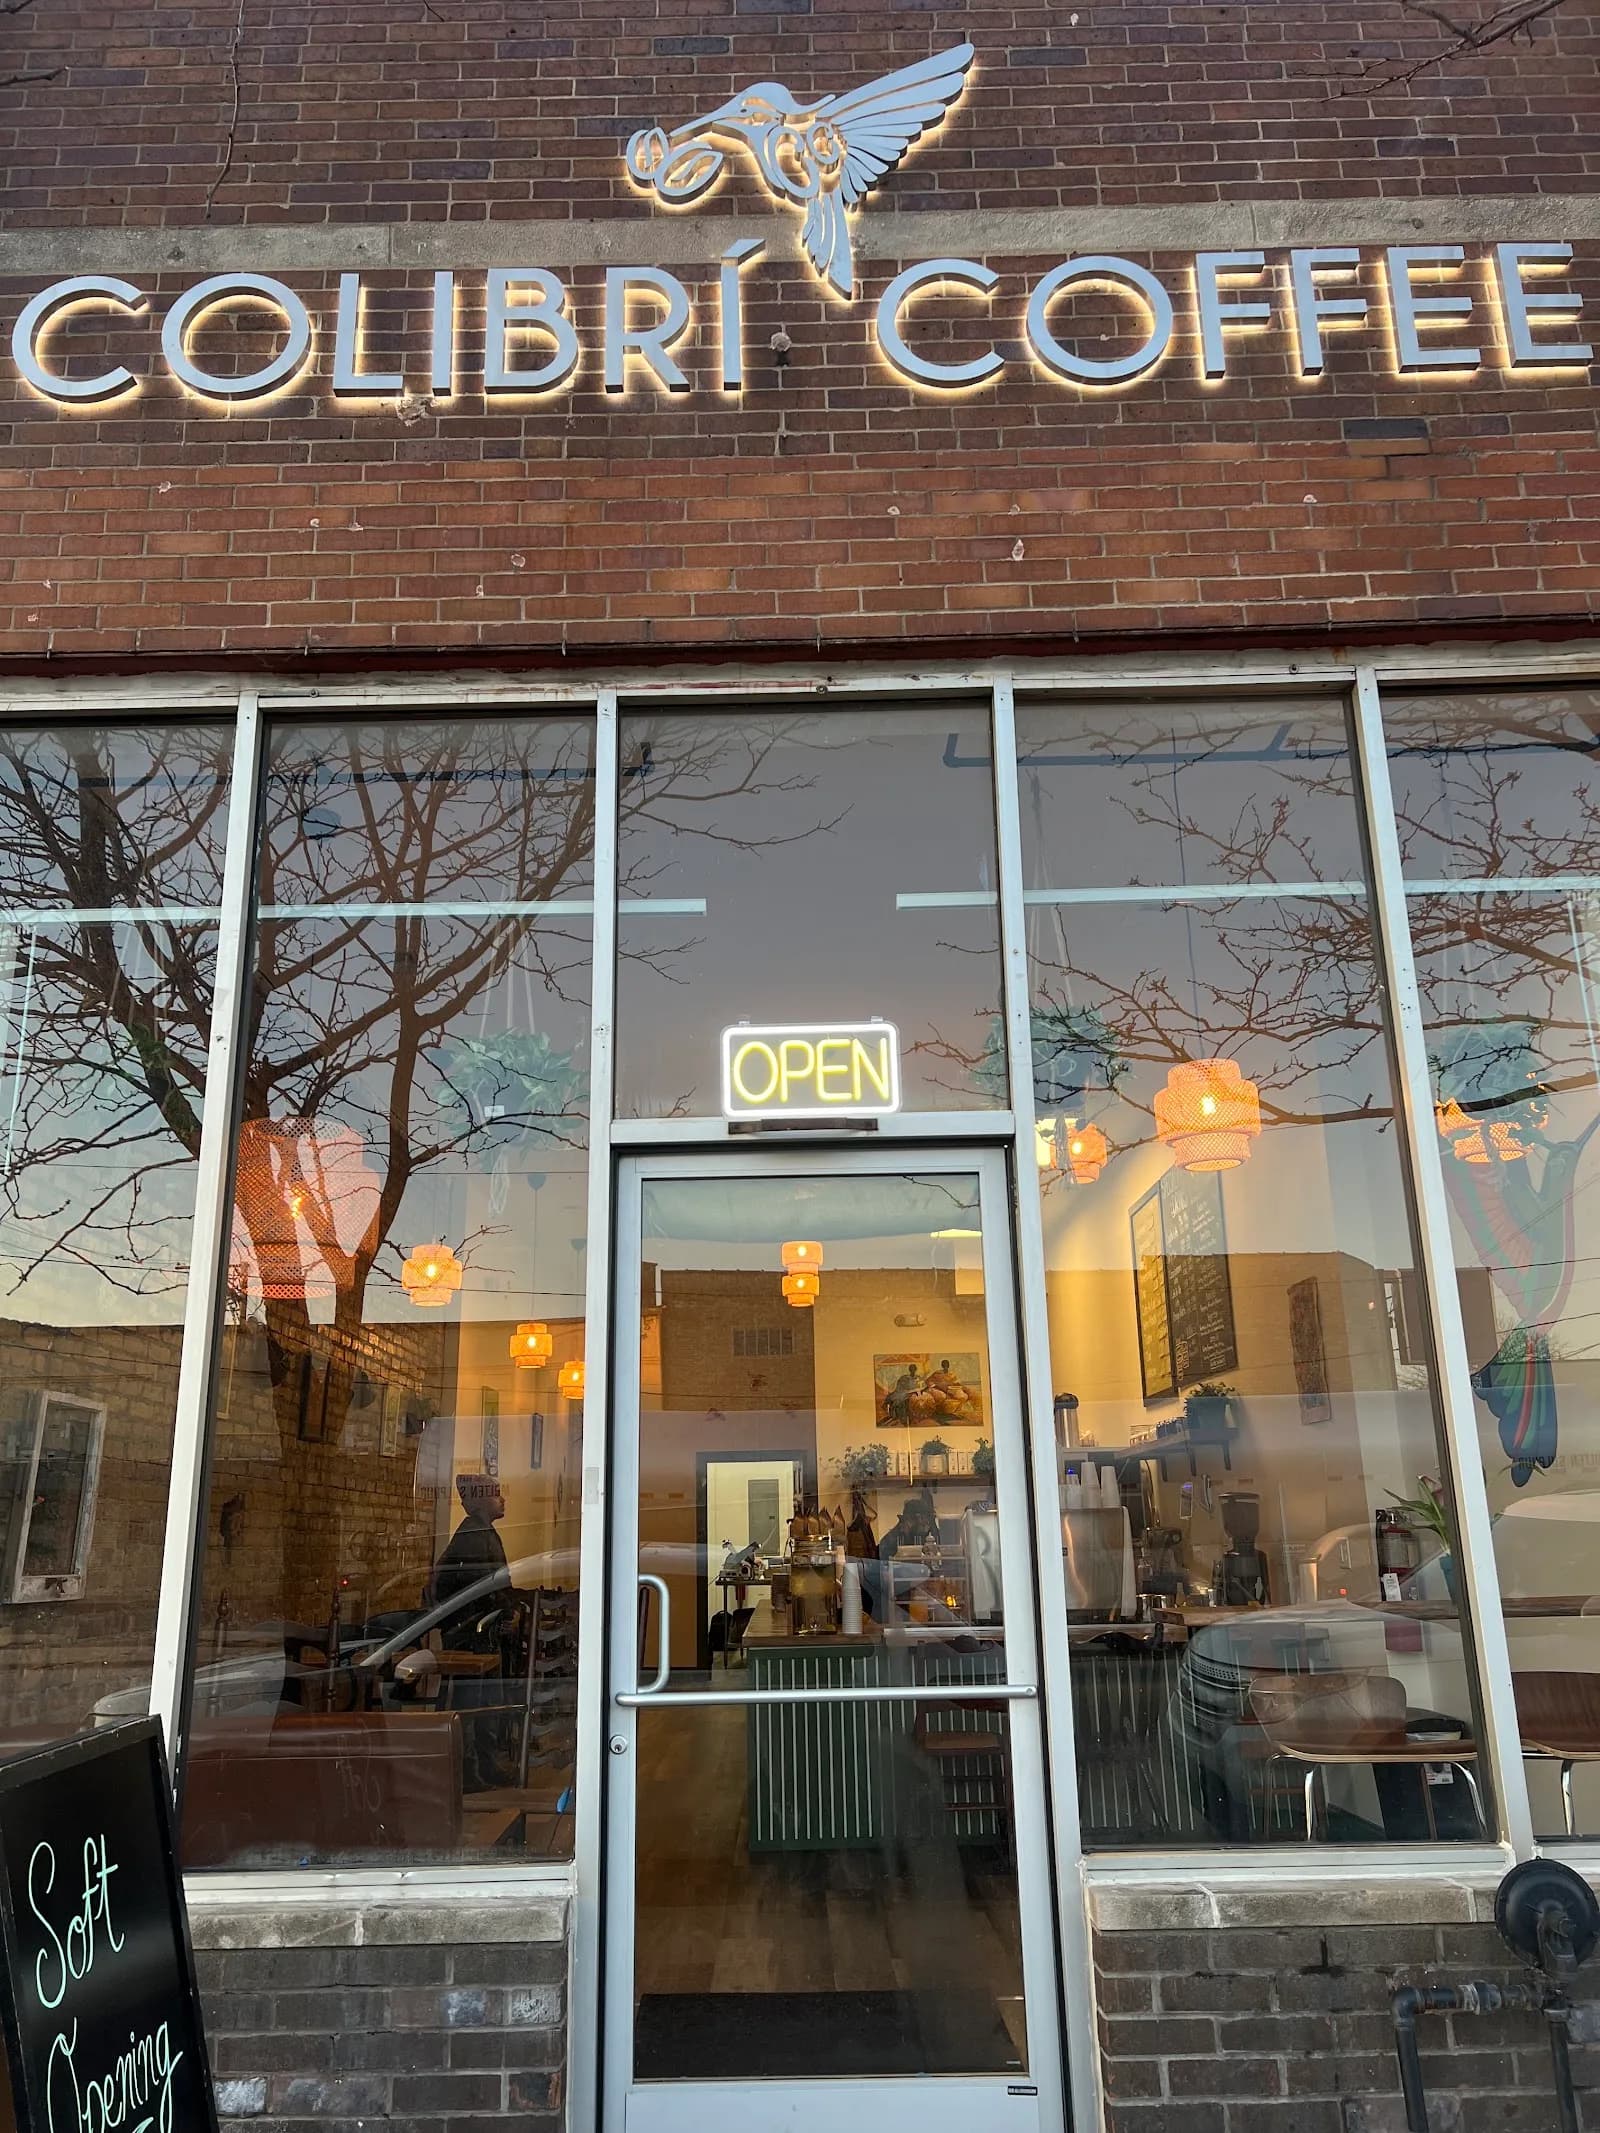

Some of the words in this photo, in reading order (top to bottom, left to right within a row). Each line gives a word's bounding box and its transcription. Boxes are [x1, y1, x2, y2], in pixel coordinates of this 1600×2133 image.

[12, 238, 765, 401] COLIBRÍ
[876, 243, 1594, 387] COFFEE
[733, 1037, 890, 1104] OPEN
[28, 1834, 125, 2009] Soft
[47, 2017, 184, 2133] Opening
